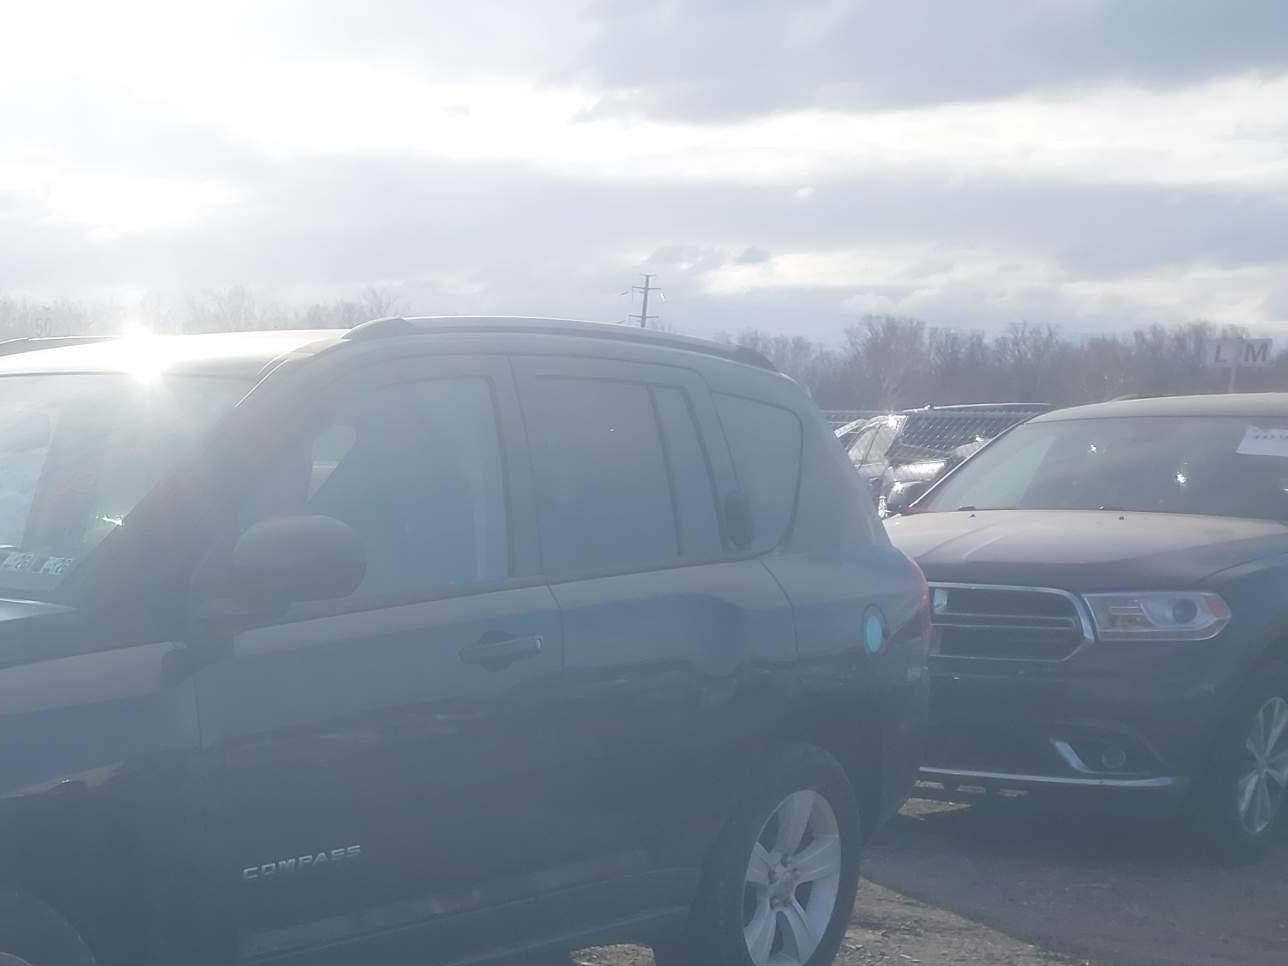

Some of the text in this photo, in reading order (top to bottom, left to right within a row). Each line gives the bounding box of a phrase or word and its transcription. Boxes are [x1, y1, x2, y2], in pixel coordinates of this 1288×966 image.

[1214, 343, 1226, 363] L
[1244, 343, 1269, 362] M
[242, 844, 362, 882] COMPASS
